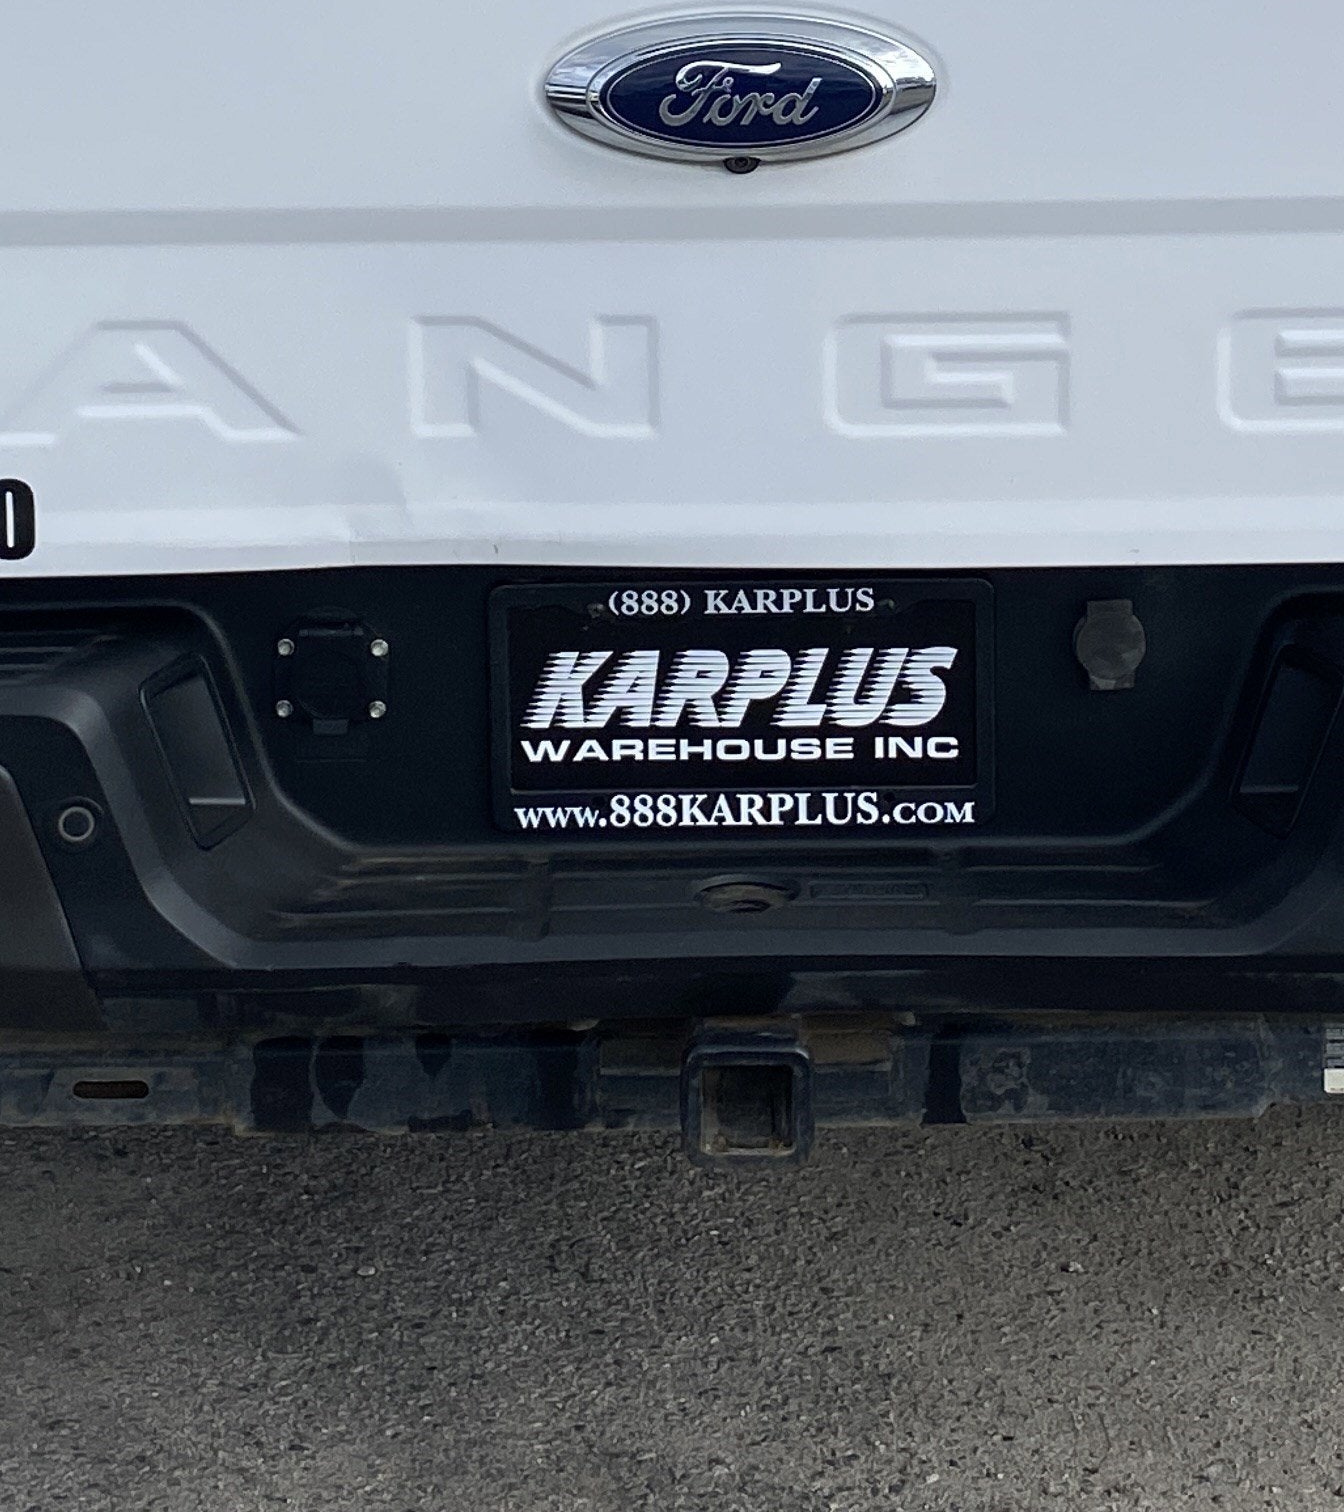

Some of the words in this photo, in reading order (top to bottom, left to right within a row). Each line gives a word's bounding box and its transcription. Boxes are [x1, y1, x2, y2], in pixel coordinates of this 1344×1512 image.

[658, 59, 823, 127] Ford
[608, 588, 692, 616] (888)
[704, 587, 876, 615] KARPLUS
[520, 646, 959, 729] KARPLUS
[520, 737, 855, 762] WAREHOUSE
[874, 736, 960, 760] INC
